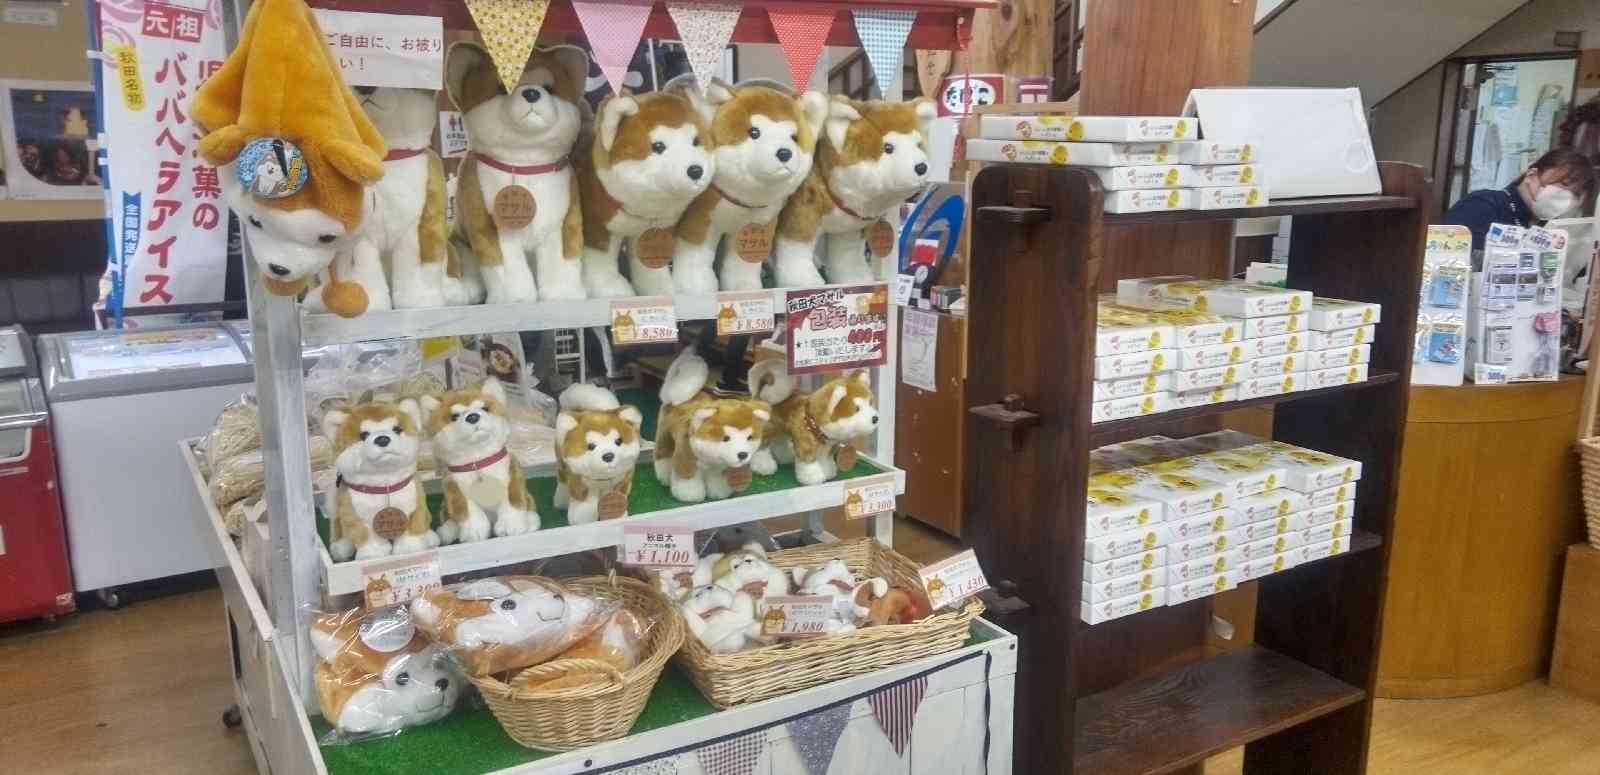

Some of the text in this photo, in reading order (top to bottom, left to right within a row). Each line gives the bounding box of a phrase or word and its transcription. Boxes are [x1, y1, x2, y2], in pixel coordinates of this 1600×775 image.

[146, 10, 199, 38] 元祖
[139, 52, 188, 305] ババヘラアイス
[647, 533, 674, 542] 秋田犬
[635, 550, 689, 563] ￥1,100
